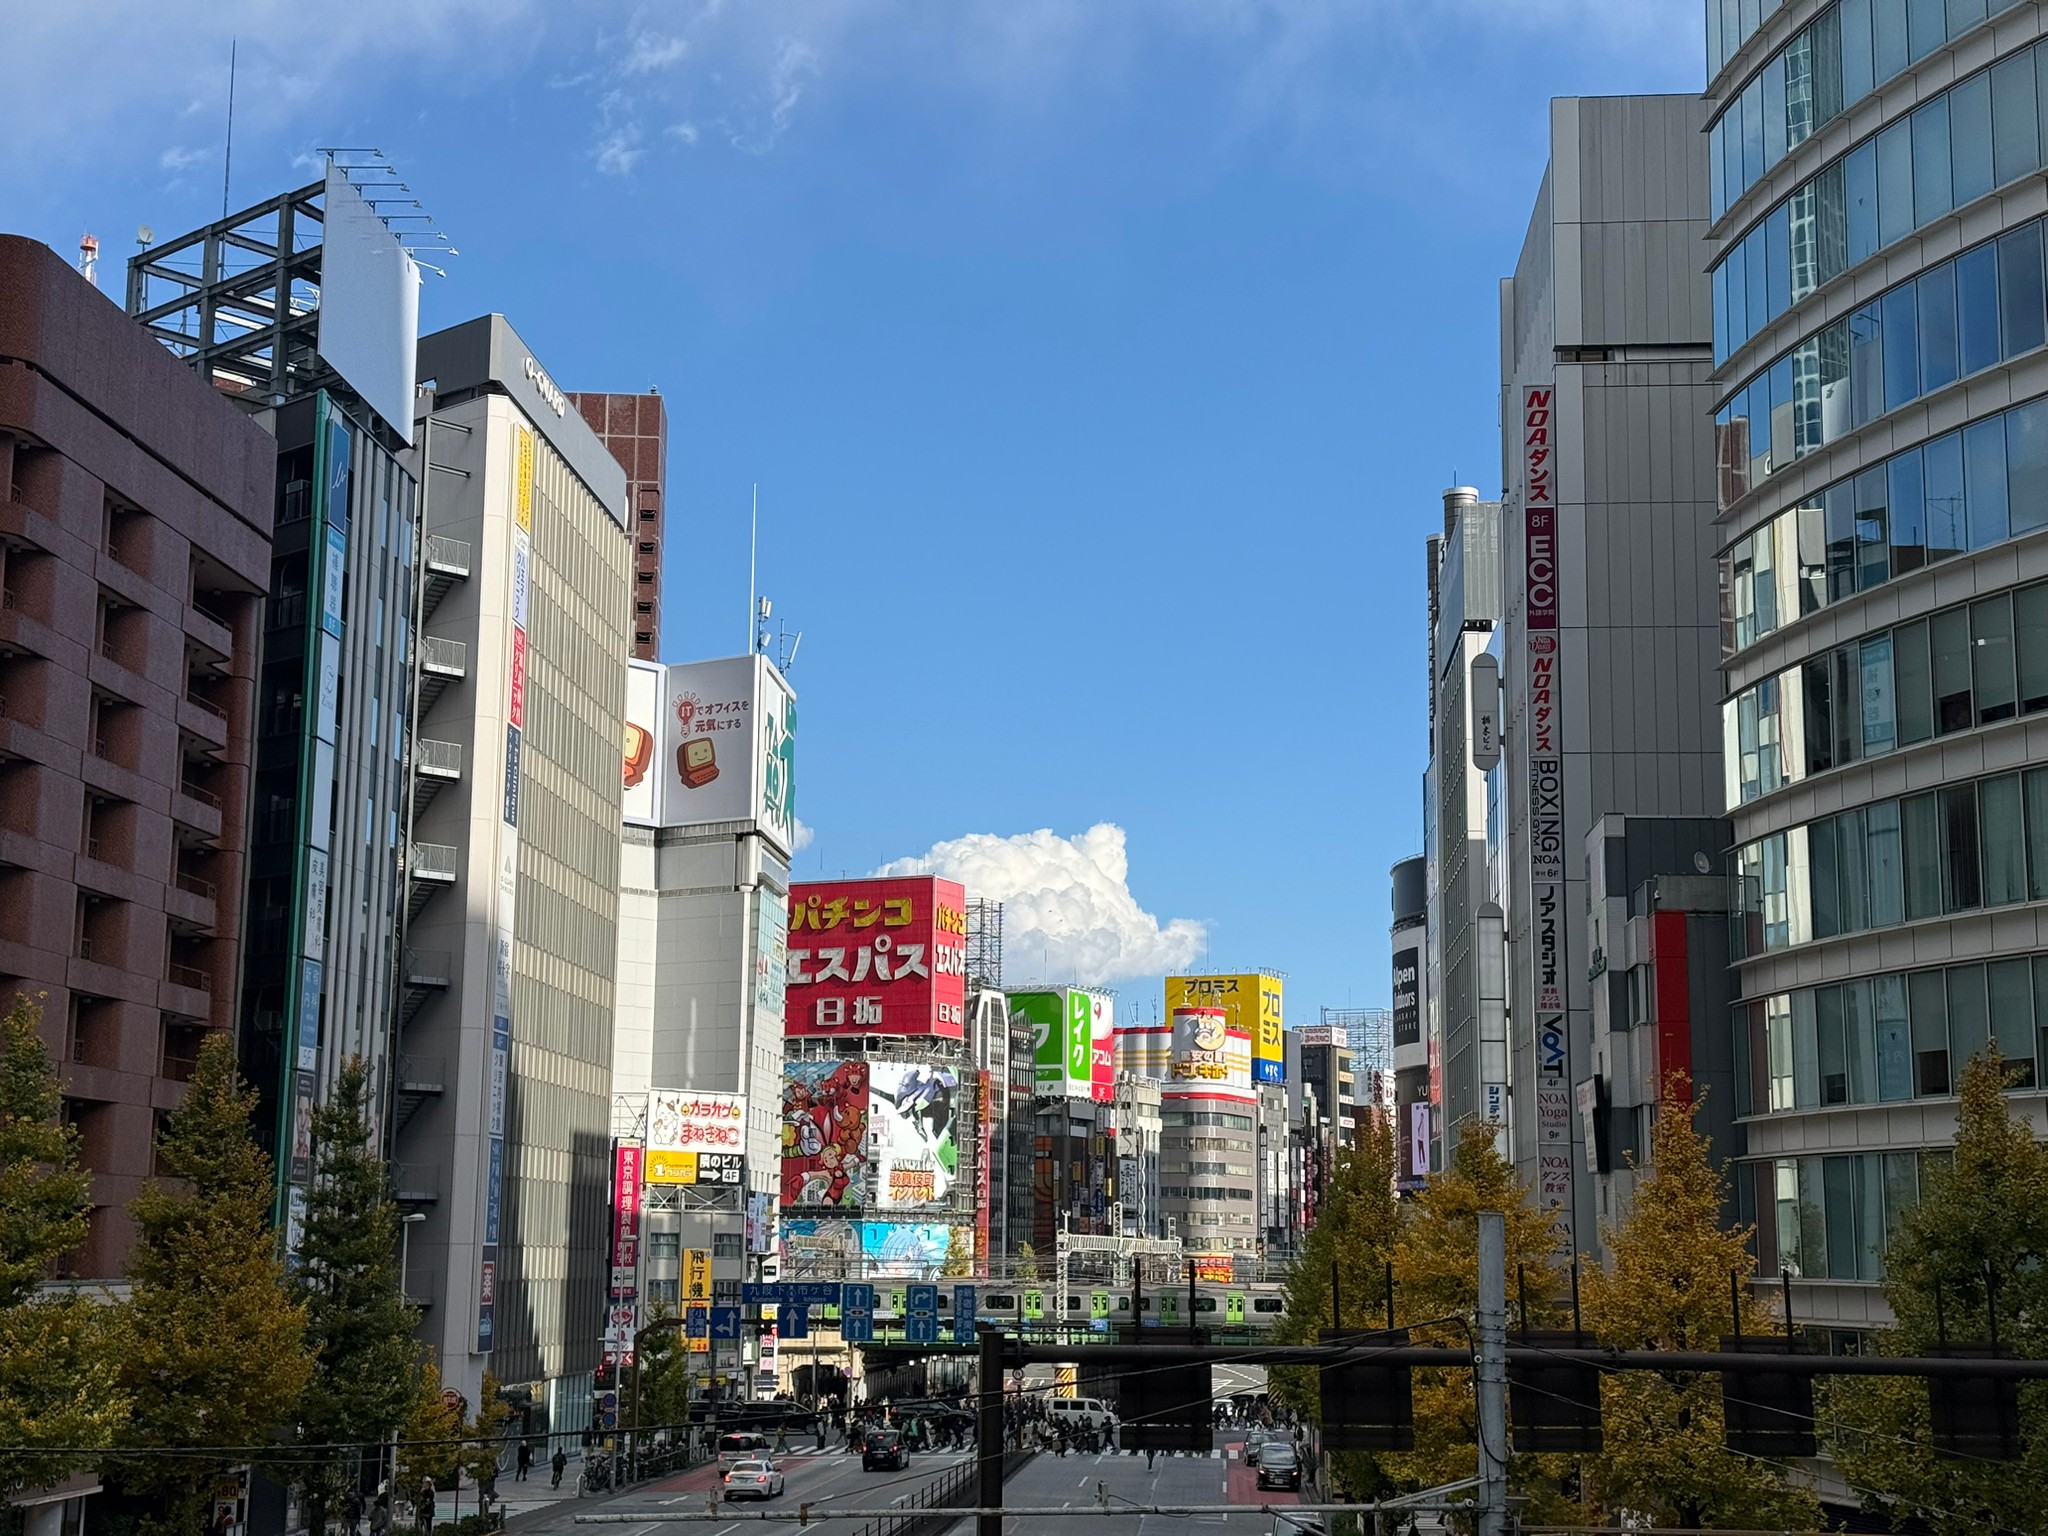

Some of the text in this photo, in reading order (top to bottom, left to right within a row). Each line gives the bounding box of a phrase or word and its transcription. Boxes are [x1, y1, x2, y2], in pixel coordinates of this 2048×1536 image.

[1526, 390, 1551, 446] NOA
[1528, 448, 1550, 502] ダンス
[1531, 515, 1549, 528] 8F
[1529, 535, 1554, 607] ECC
[1529, 609, 1555, 617] 外語学院
[1532, 657, 1553, 704] NOA
[680, 699, 749, 718] IT でオフィスを
[695, 718, 742, 733] 元気にする
[1535, 706, 1552, 752] ダンス
[1531, 760, 1540, 847] FITNESS GYM
[1539, 760, 1559, 853] BOXING
[1533, 854, 1560, 865] NOA
[1547, 868, 1559, 878] 6F
[790, 893, 913, 931] パチンコ
[937, 903, 965, 935] パチンコ
[1540, 885, 1557, 985] ノアスタジオ
[787, 933, 929, 984] エスパス
[937, 940, 965, 976] エスパス
[1185, 979, 1240, 995] プロミス
[1073, 995, 1085, 1068] レイク
[1398, 1022, 1417, 1033] STORE
[1092, 1048, 1112, 1067] アコム
[1547, 1079, 1559, 1087] 4F
[1539, 1093, 1568, 1104] NOA
[689, 1102, 734, 1119] カラオケ
[1539, 1106, 1568, 1119] Yoga
[680, 1121, 741, 1147] まねきねこ
[1549, 1131, 1560, 1139] 9F
[699, 1154, 742, 1169] 隣のビル
[1541, 1157, 1570, 1168] NOA
[724, 1171, 738, 1181] 4F
[889, 1171, 935, 1186] 歌舞伎町
[1542, 1172, 1570, 1182] ダンス
[888, 1186, 935, 1201] インパクト
[1544, 1182, 1567, 1194] 教室
[691, 1250, 705, 1298] 飛行機
[483, 1268, 492, 1298] 薬
[749, 1285, 785, 1296] 九段下
[963, 1288, 973, 1340] 新宿駅東口
